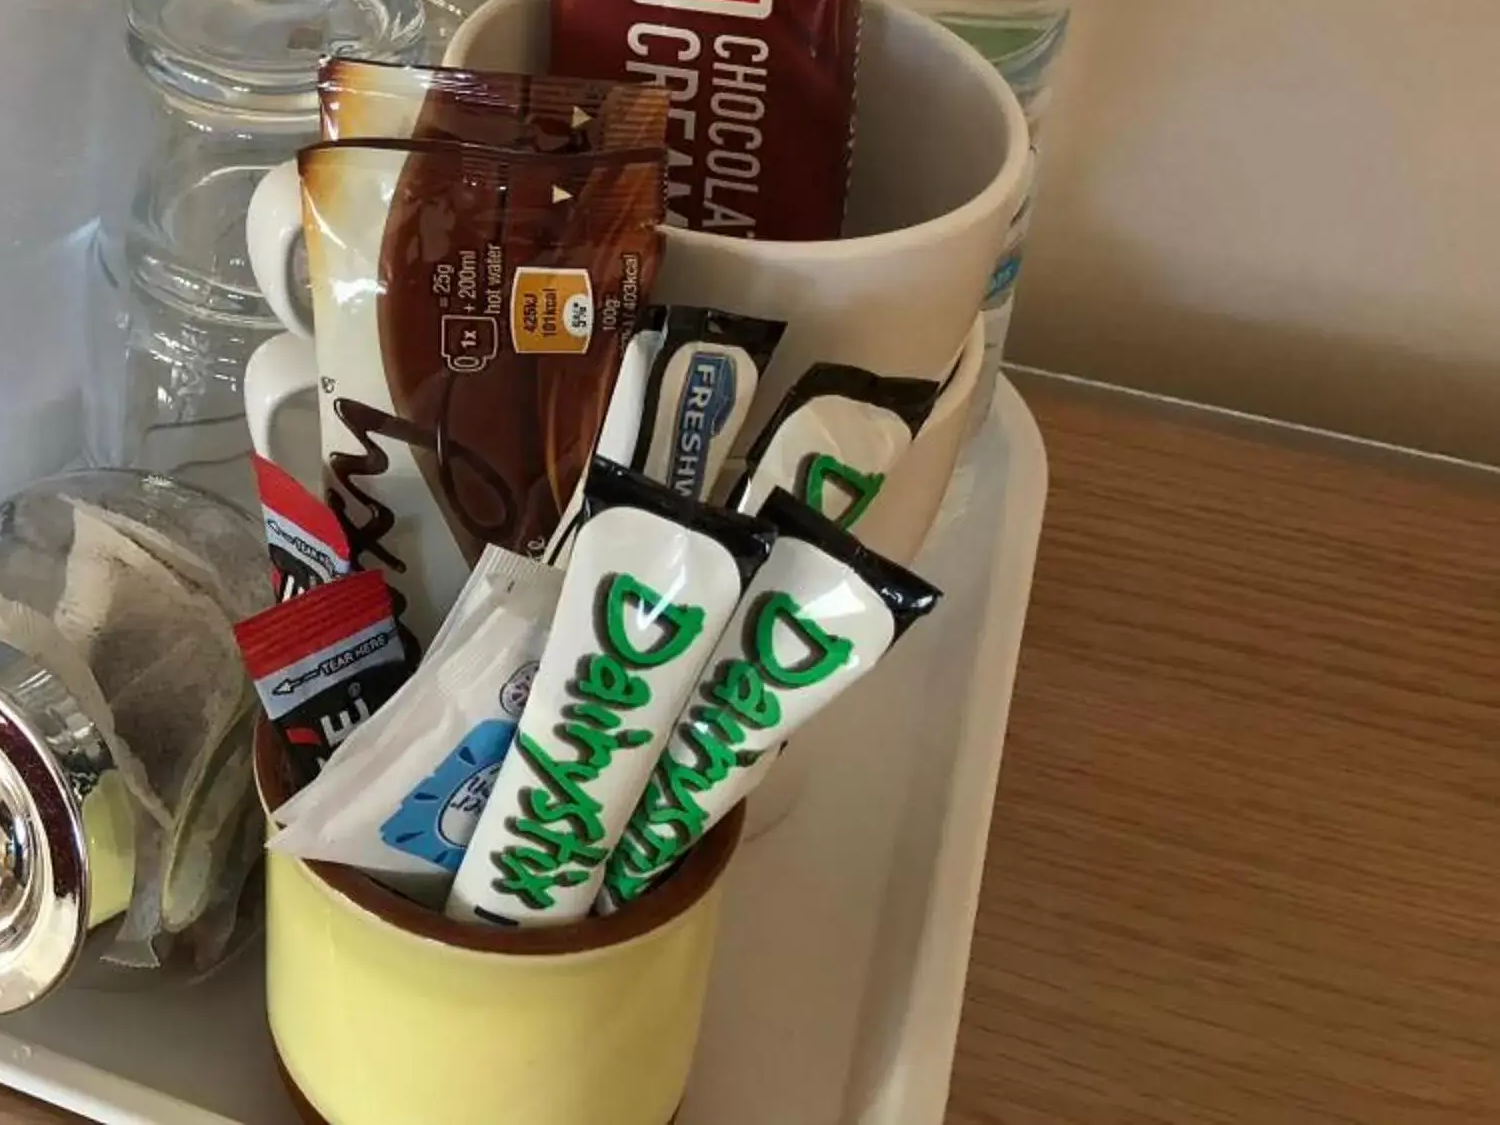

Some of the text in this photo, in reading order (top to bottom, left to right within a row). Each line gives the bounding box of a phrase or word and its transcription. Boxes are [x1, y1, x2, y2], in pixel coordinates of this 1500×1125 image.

[701, 35, 769, 239] CHOCOLA
[432, 264, 455, 294] 25g
[458, 250, 476, 299] 200ml
[483, 243, 501, 314] hot water
[542, 288, 557, 336] 101kcal
[460, 330, 477, 348] 1x
[320, 648, 353, 675] TEAR
[494, 573, 705, 909] Dairystix
